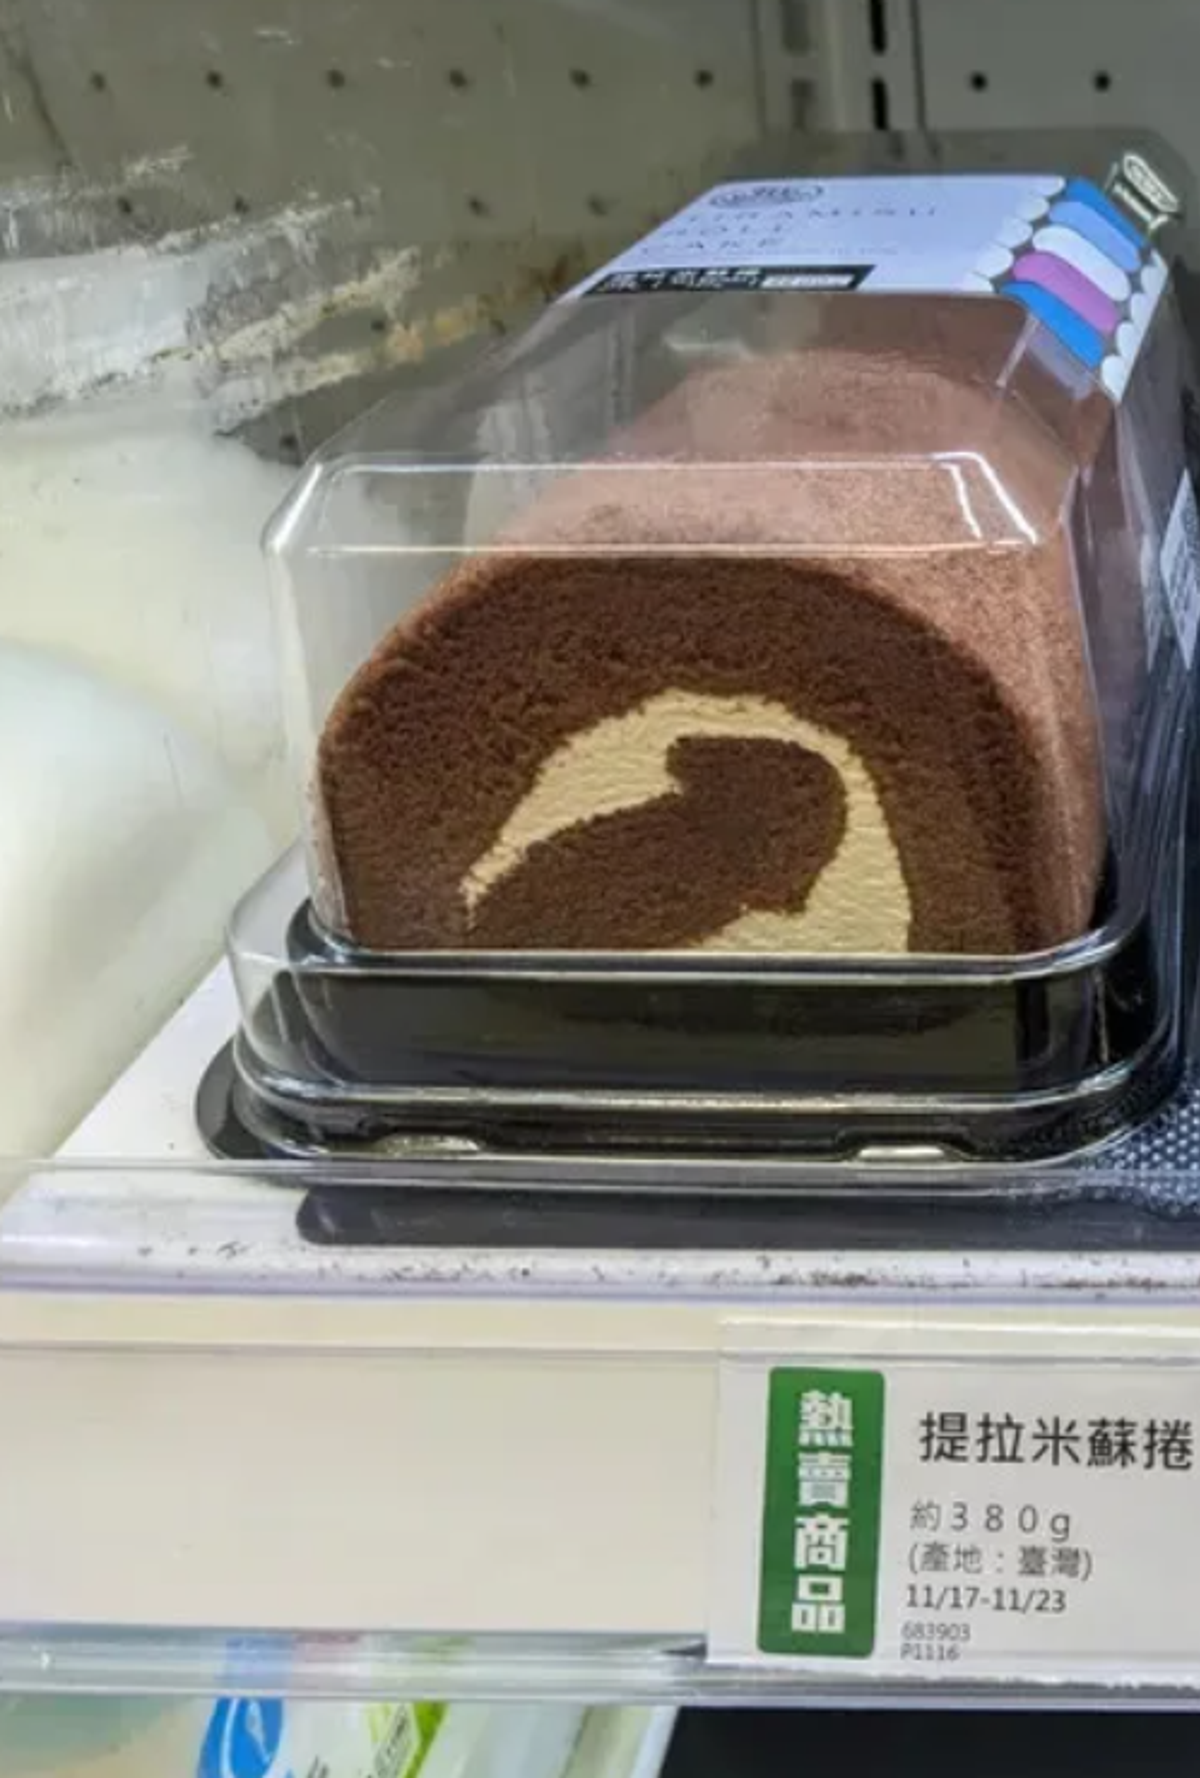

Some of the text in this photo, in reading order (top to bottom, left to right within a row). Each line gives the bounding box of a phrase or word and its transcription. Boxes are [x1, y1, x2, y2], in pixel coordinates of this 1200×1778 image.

[919, 1411, 1194, 1471] 提拉米蘇捲
[791, 1390, 853, 1634] 熱賣商品
[906, 1583, 1067, 1614] 11/17-11/23
[901, 1620, 971, 1642] 683903
[900, 1642, 961, 1661] P1116
